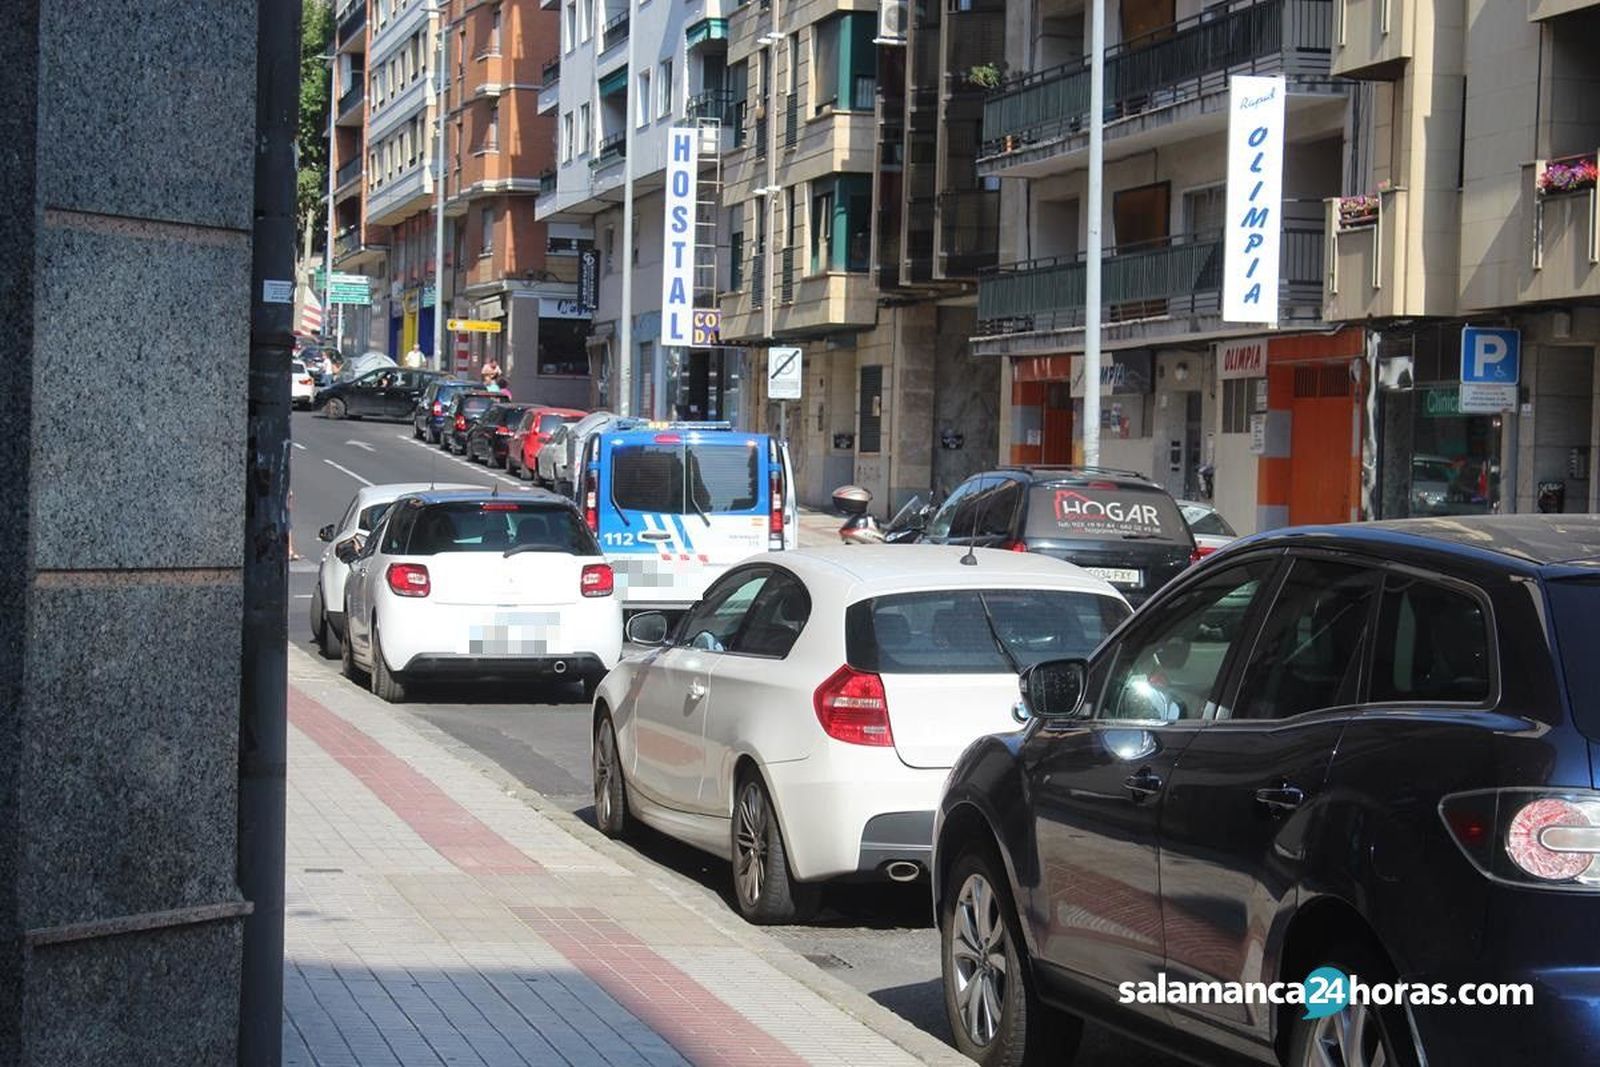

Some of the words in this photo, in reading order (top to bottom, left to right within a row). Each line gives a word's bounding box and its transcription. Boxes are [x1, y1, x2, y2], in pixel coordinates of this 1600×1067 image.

[1241, 126, 1269, 304] OLIMPIA
[668, 134, 691, 340] HOSTAL
[1224, 343, 1262, 372] OLIMPIA
[1473, 334, 1508, 377] P
[1062, 500, 1160, 526] HOGAR
[604, 533, 634, 546] 112
